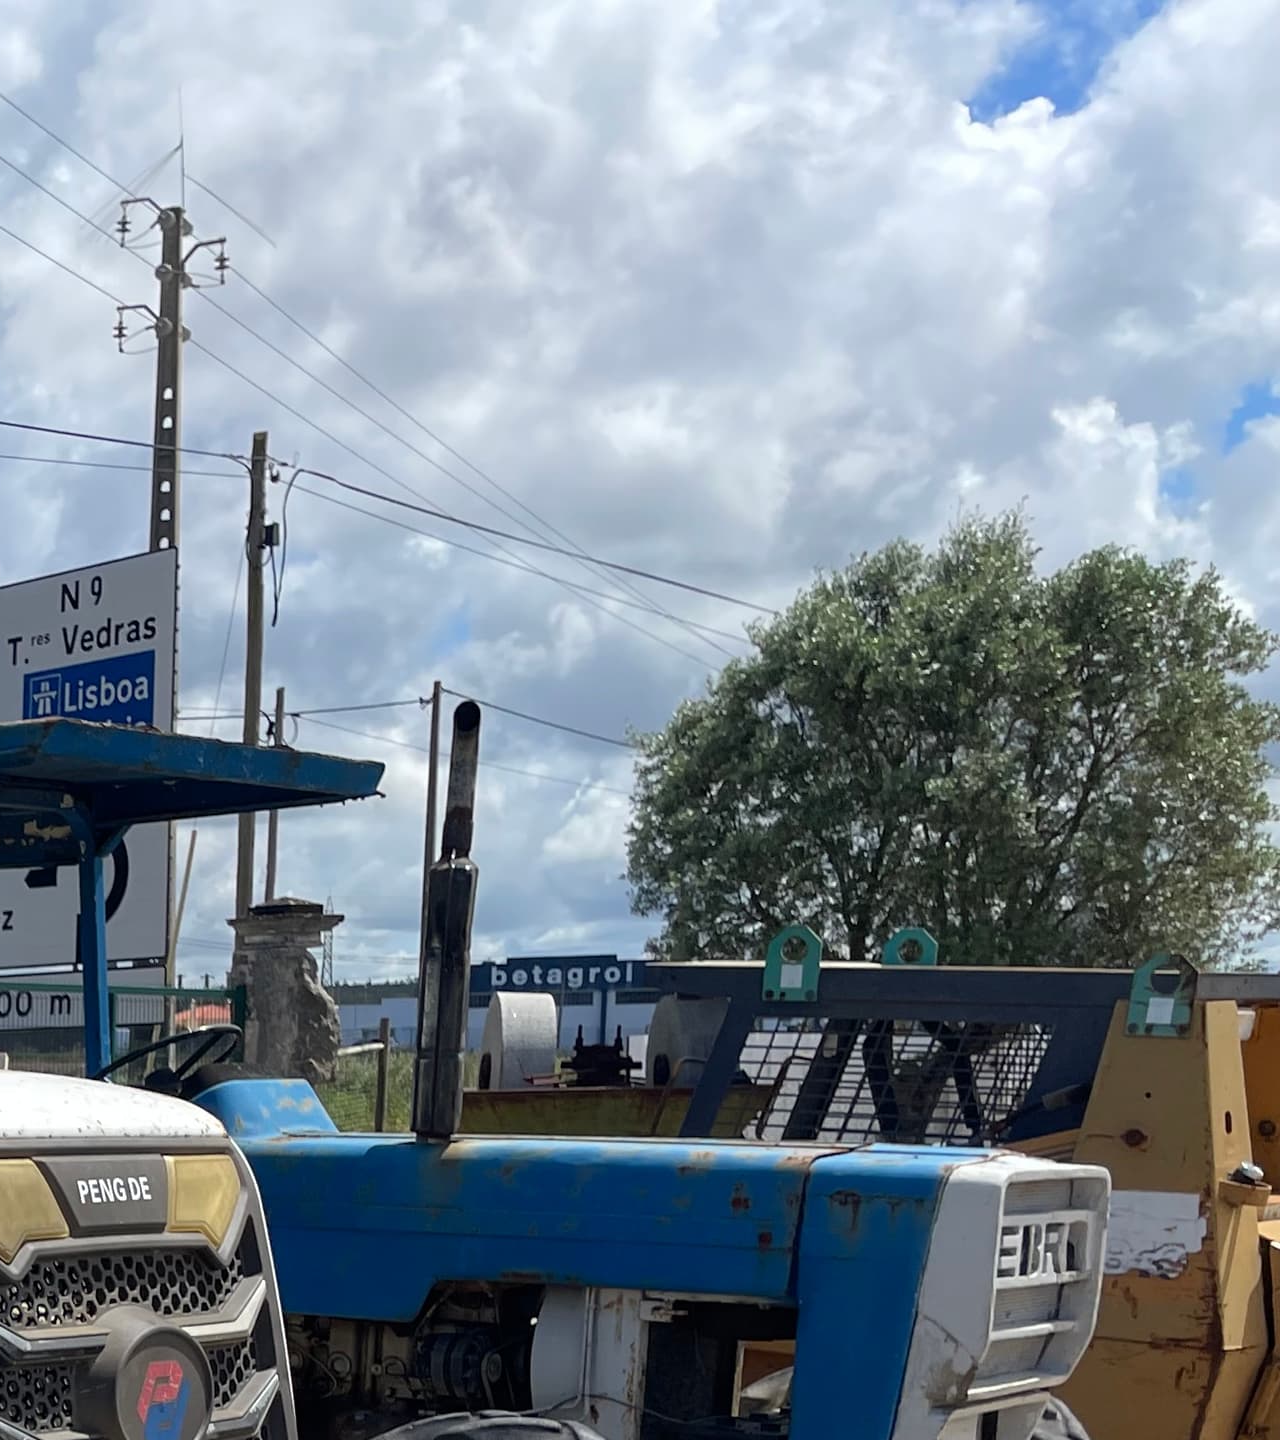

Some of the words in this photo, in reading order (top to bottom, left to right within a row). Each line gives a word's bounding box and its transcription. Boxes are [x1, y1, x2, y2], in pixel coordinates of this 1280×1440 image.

[60, 580, 80, 613] N
[90, 575, 103, 606] 9
[62, 616, 157, 655] Vedras
[63, 675, 149, 713] Lisboa
[491, 962, 633, 988] betagrol
[50, 993, 72, 1016] m
